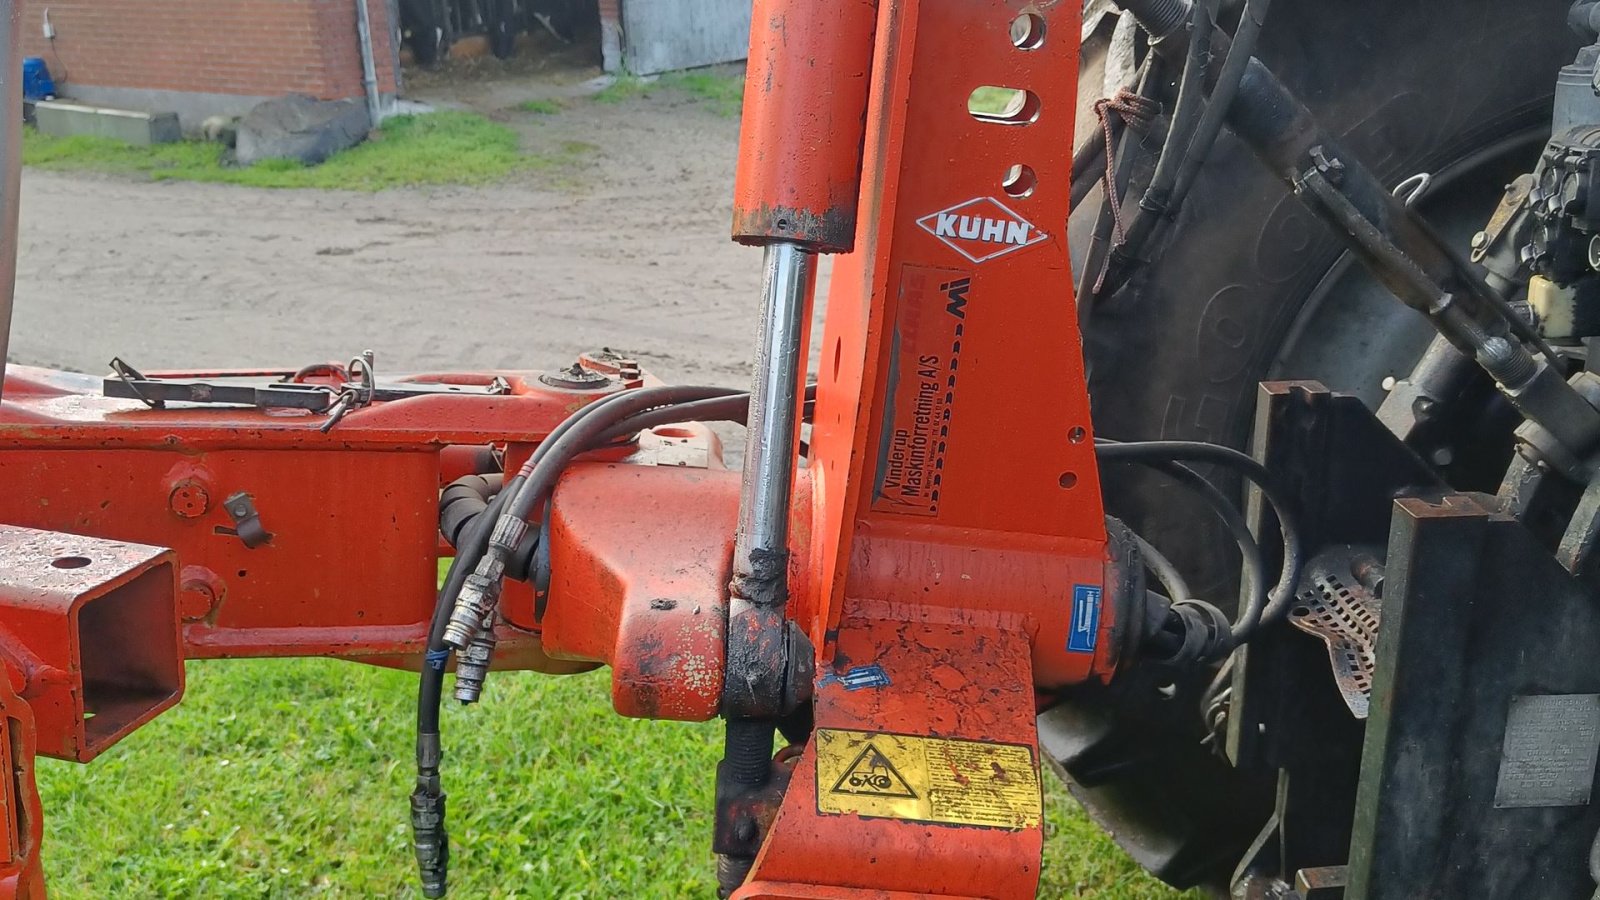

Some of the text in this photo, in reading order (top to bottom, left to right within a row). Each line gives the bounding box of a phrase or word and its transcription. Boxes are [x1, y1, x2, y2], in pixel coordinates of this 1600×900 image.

[935, 212, 1030, 245] KUHN
[901, 355, 941, 496] Maskinforretning A/S
[884, 429, 910, 488] Vinderup
